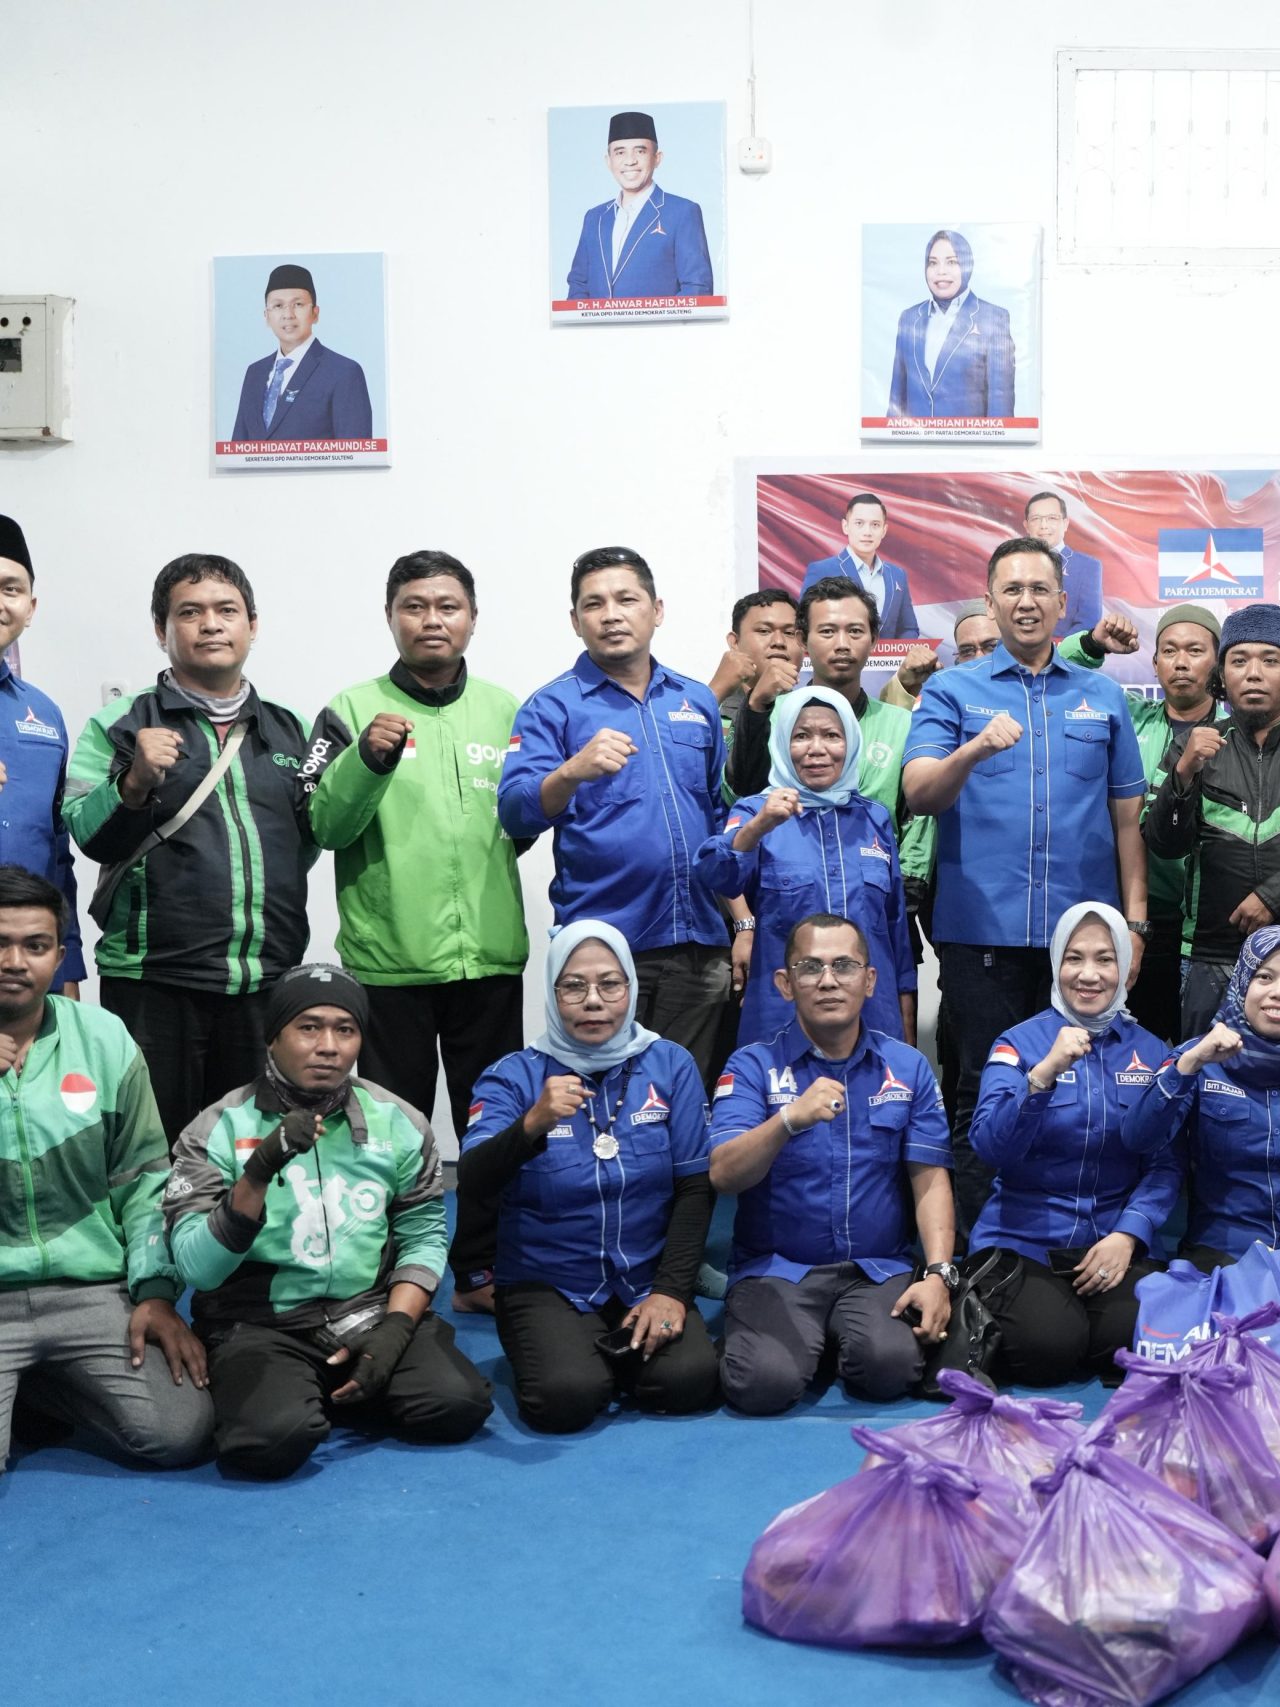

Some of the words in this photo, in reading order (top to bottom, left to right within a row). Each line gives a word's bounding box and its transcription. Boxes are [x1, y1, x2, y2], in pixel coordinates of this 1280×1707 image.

[577, 301, 590, 310] Dr.
[592, 300, 603, 309] H.
[604, 299, 643, 309] ANWAR
[914, 418, 964, 428] JUMRIANI
[966, 418, 1005, 428] HAMKA
[223, 443, 234, 453] H.
[235, 442, 259, 453] MOH
[260, 442, 301, 453] HIDAYAT
[303, 440, 378, 452] PAKAMUNDI,SE
[1164, 587, 1199, 596] PARTAI
[1200, 586, 1258, 596] DEMOKRAT
[767, 1065, 799, 1094] 14
[1207, 1082, 1220, 1090] SITI
